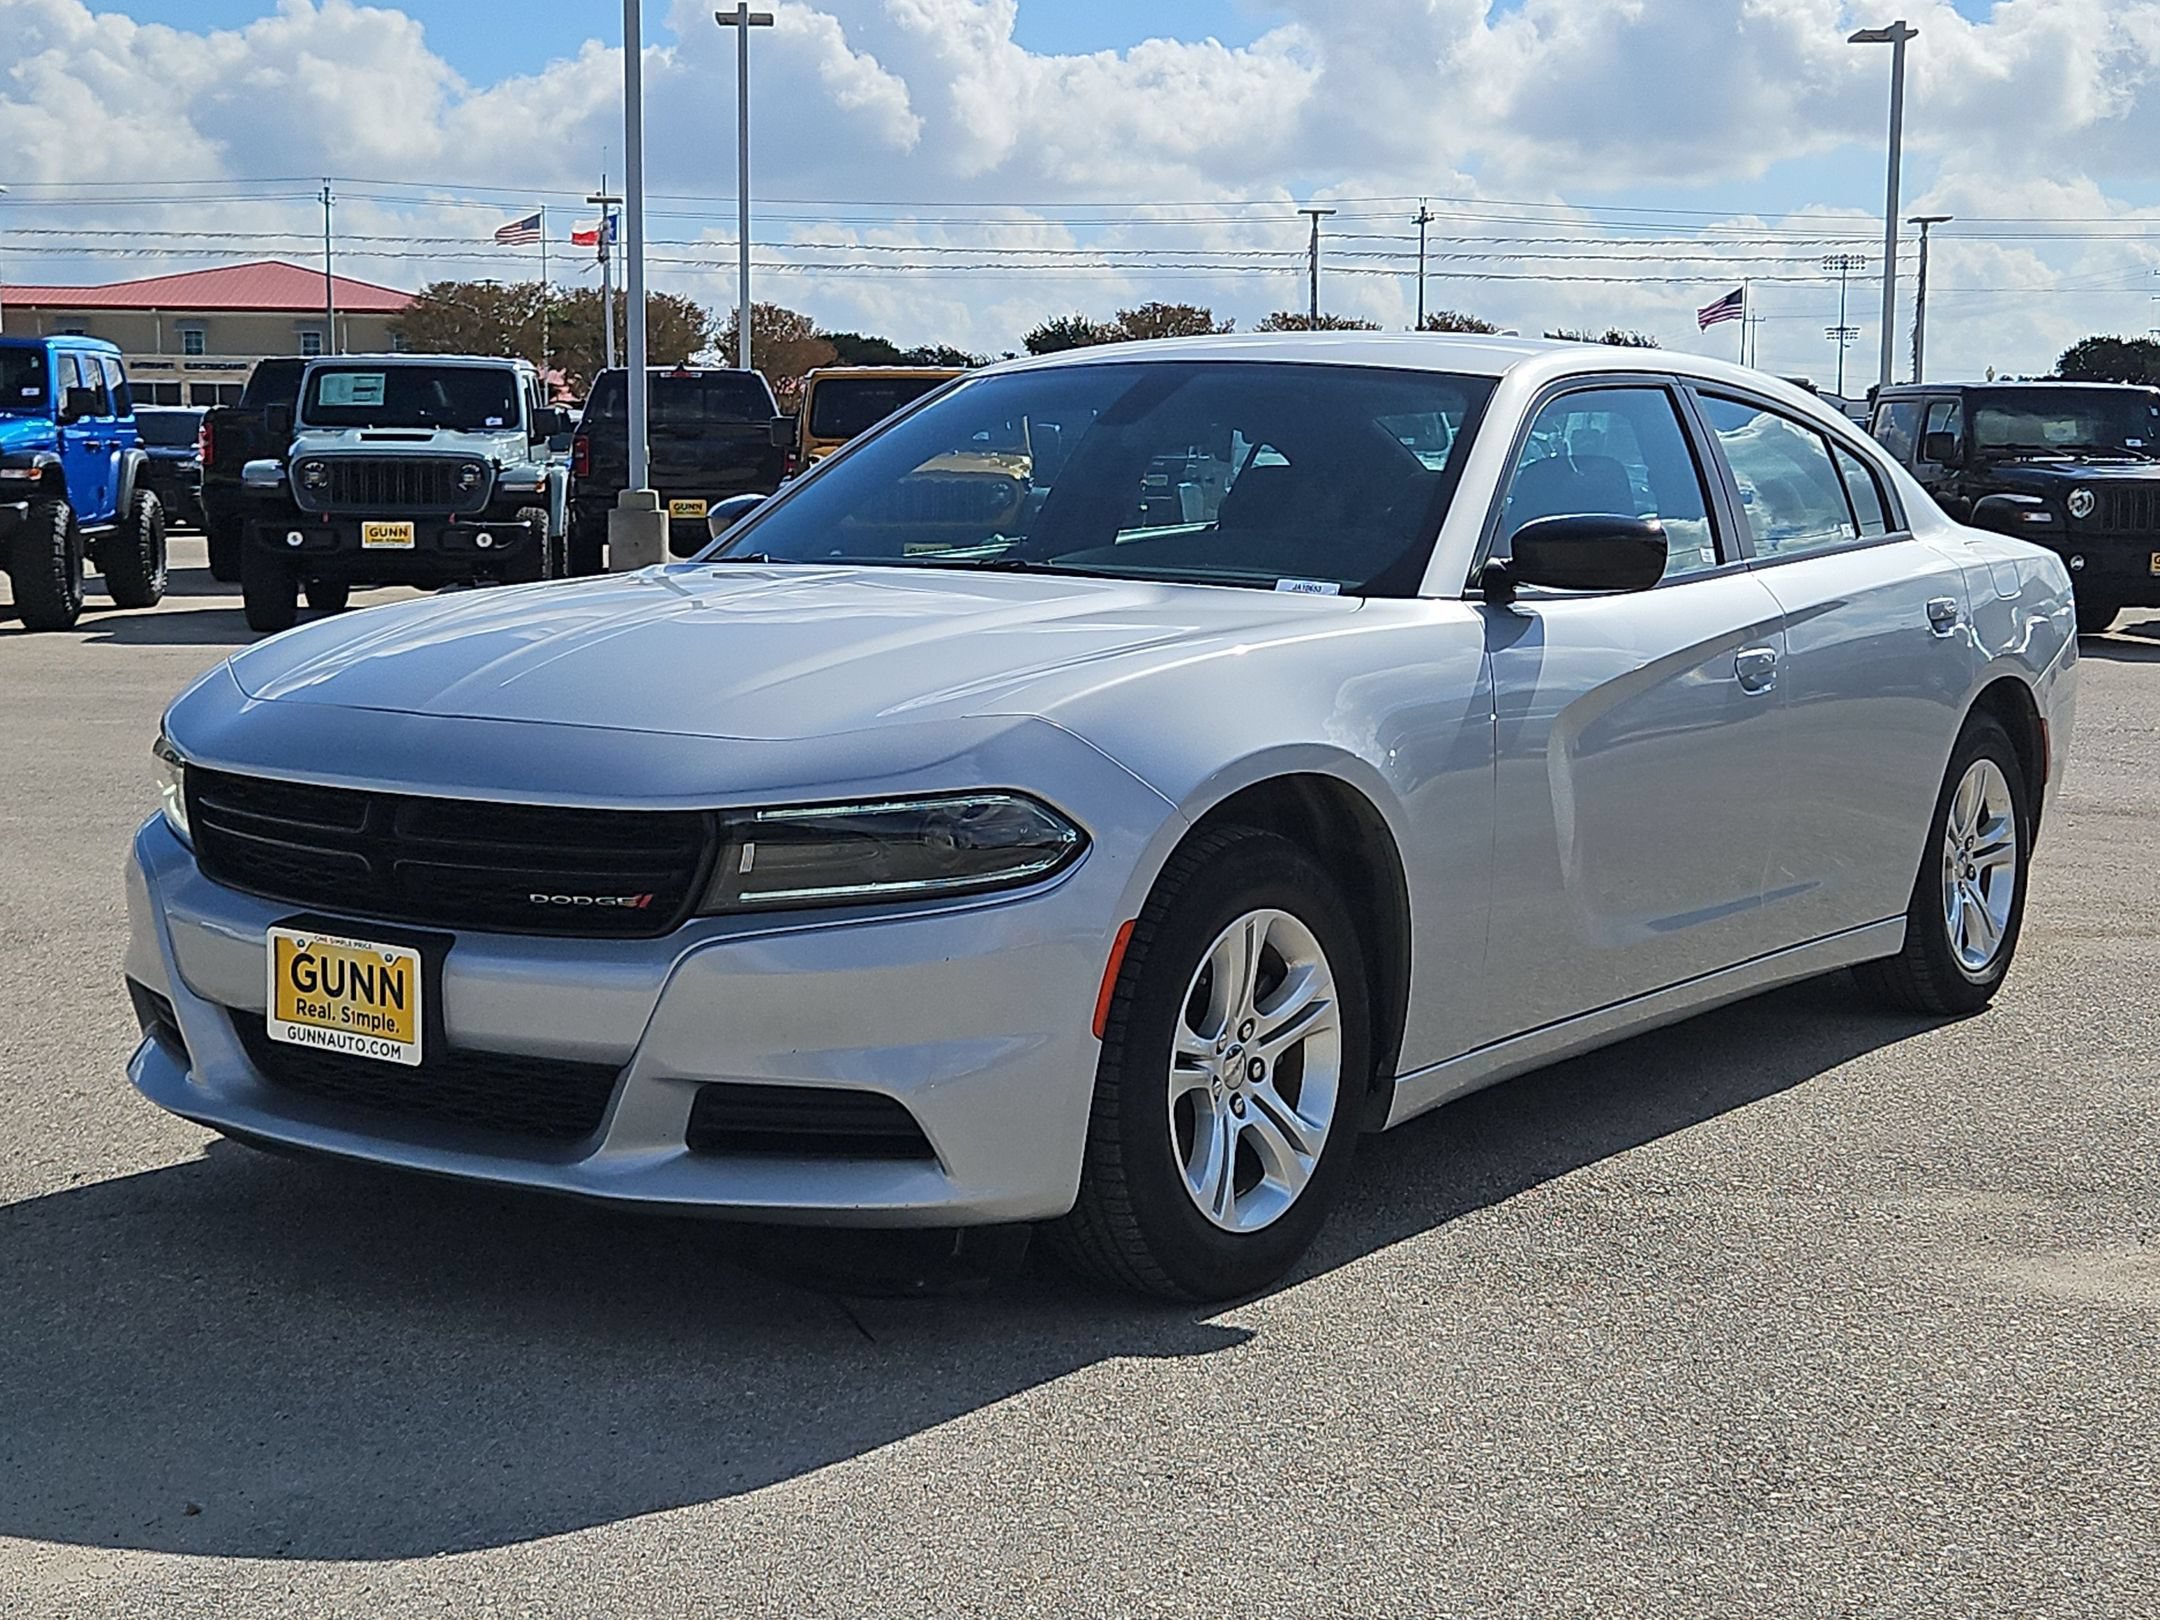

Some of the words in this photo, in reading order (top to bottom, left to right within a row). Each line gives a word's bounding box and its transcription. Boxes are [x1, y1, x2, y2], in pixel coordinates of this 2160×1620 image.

[673, 503, 702, 511] GUNN
[369, 527, 408, 537] GUNN
[529, 893, 638, 907] DODGE
[291, 953, 404, 1011] GUNN
[296, 998, 336, 1021] Real.
[287, 1025, 401, 1059] GUNNAUTO.COM
